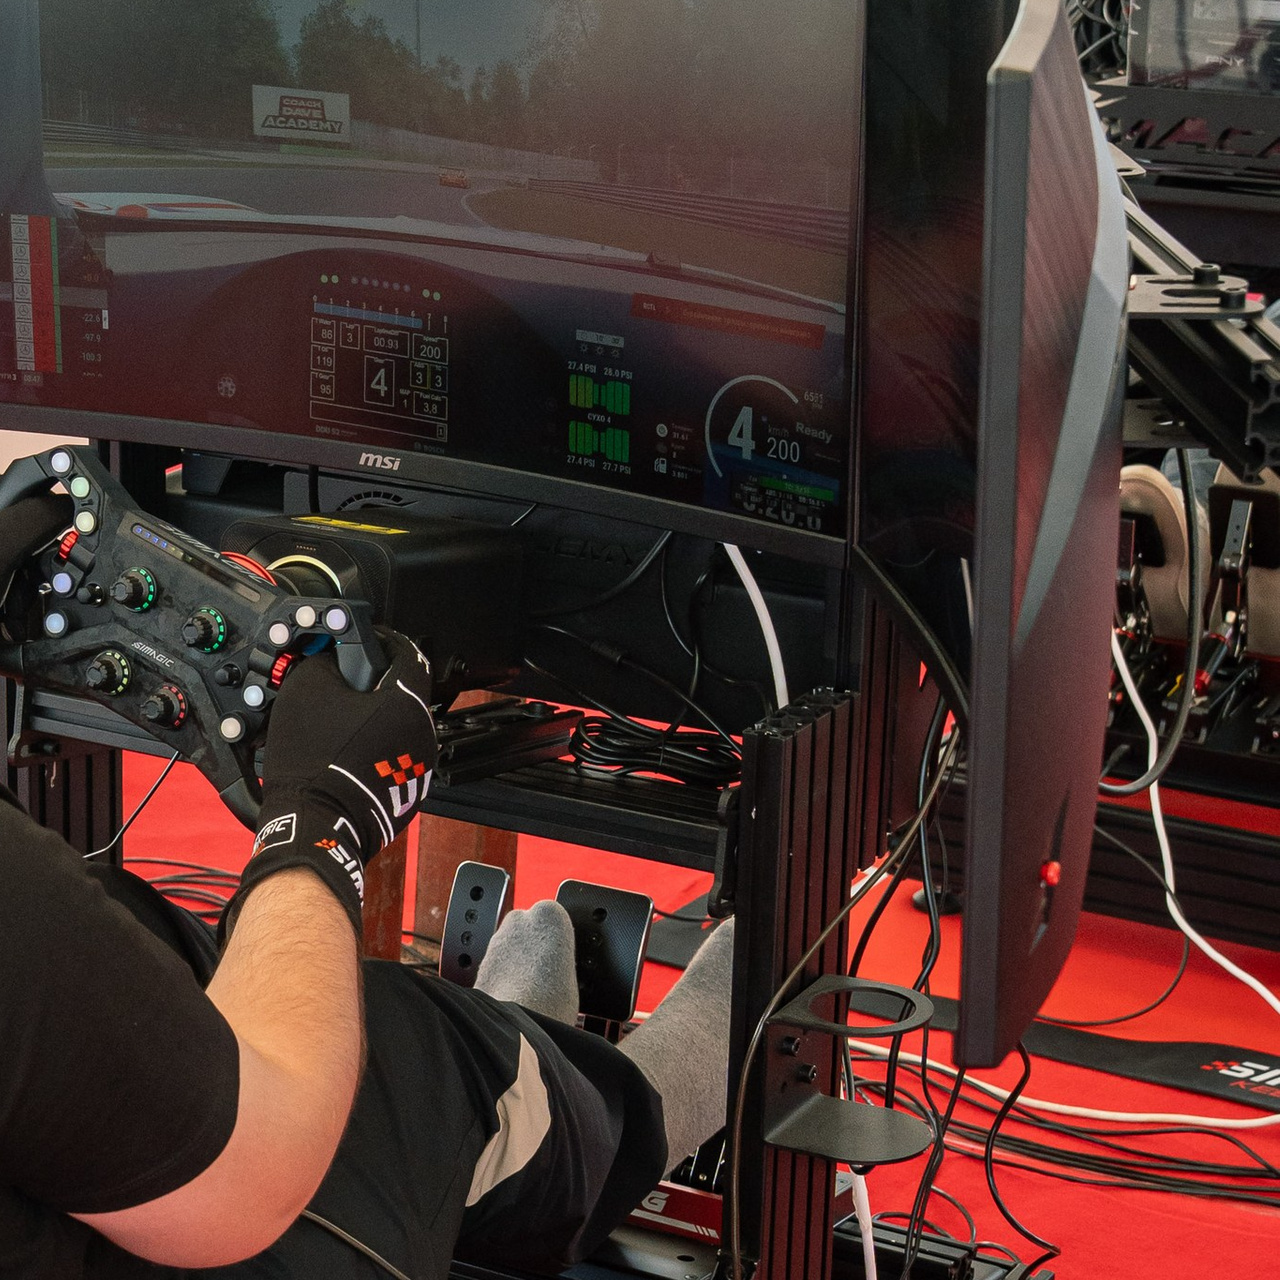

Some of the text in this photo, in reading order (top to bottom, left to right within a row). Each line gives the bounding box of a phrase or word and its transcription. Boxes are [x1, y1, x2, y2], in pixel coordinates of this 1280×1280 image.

[1205, 55, 1245, 68] PNY
[282, 97, 322, 108] COACH
[281, 106, 323, 119] DAVE
[264, 116, 341, 133] ACADEMY
[321, 328, 333, 340] 86
[346, 332, 353, 344] 3
[419, 345, 441, 360] 200
[316, 355, 333, 367] 119
[567, 361, 597, 374] 27.4 PSI
[415, 372, 423, 385] 3
[621, 369, 634, 380] PSI
[370, 367, 388, 398] 4
[434, 375, 442, 388] 3
[319, 383, 332, 395] 95
[727, 405, 756, 461] 4
[795, 422, 833, 444] Ready
[766, 437, 801, 463] 200
[359, 452, 402, 472] msi
[566, 454, 596, 468] 27.4 PSI
[619, 464, 632, 475] PSI
[131, 641, 175, 667] SIMAGIC
